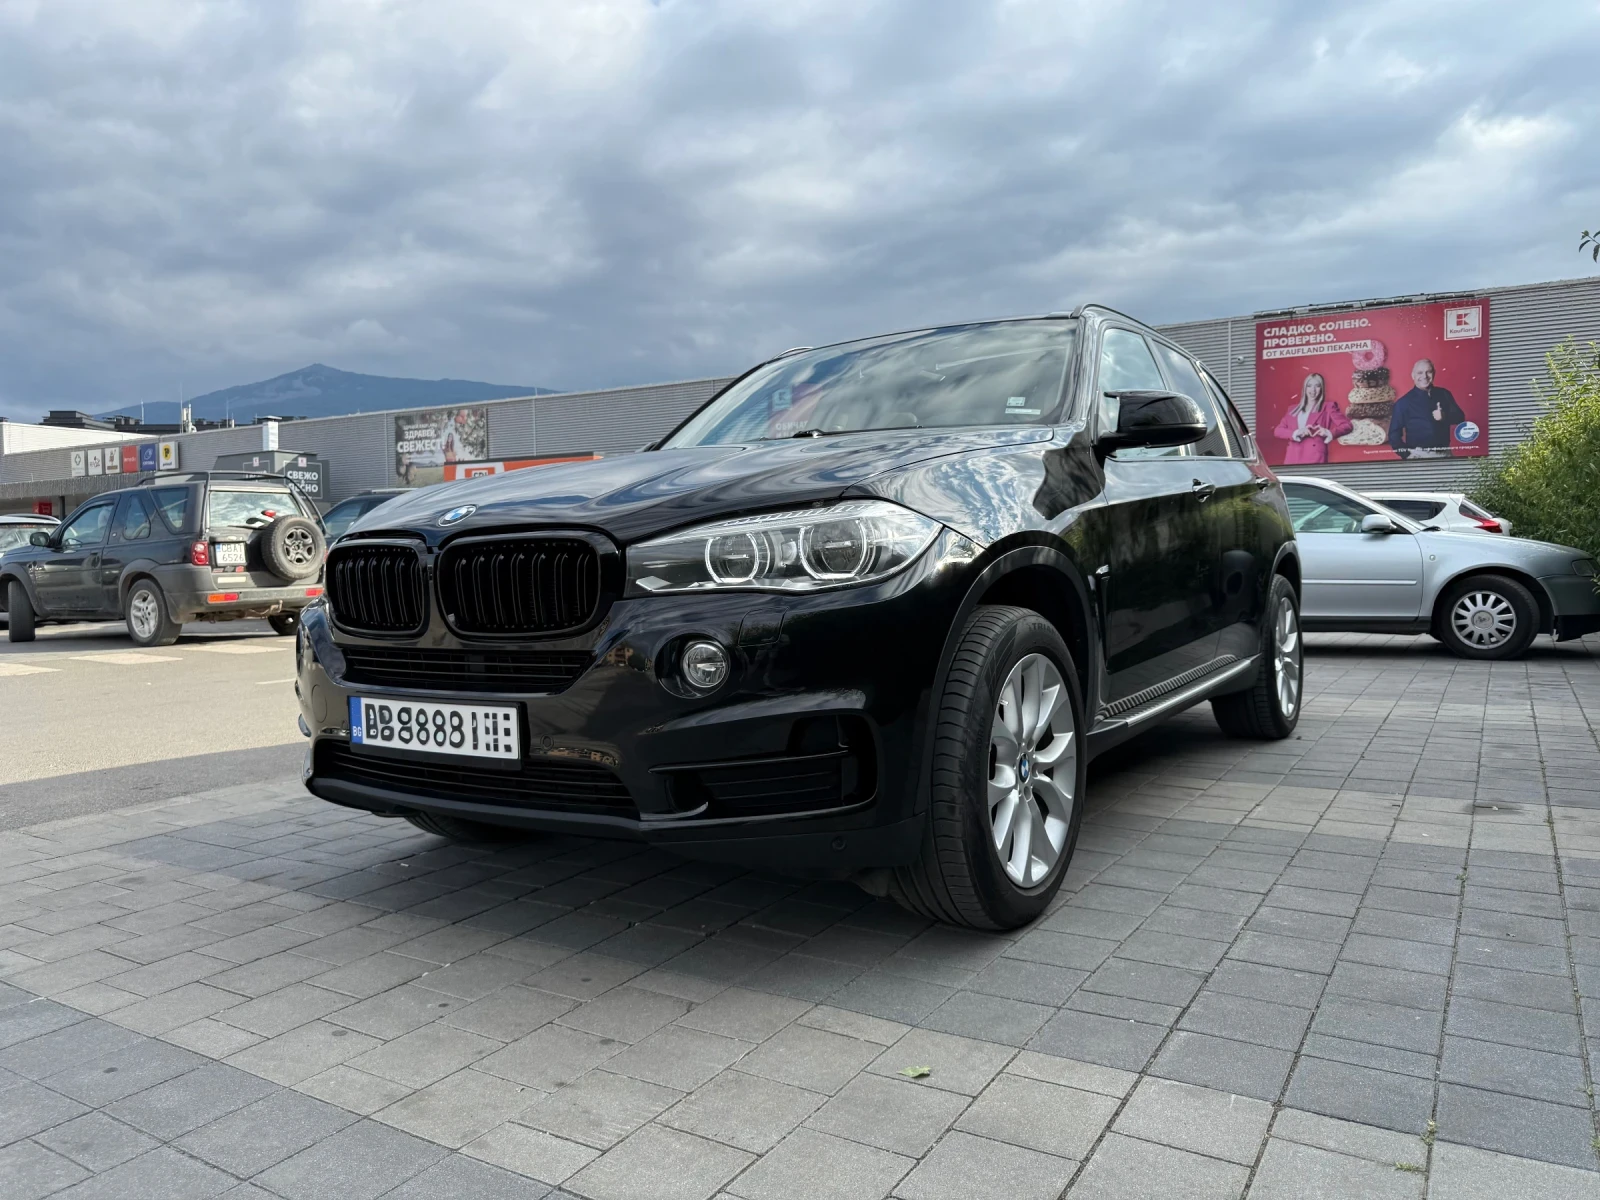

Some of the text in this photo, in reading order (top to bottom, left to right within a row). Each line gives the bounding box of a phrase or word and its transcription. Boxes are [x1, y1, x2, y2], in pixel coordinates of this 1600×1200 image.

[1263, 318, 1372, 337] СЛАДКО. СОЛЕНО.
[1263, 333, 1337, 348] ПРОВЕРЕНО.
[1265, 342, 1369, 358] ОТ KAUFLAND ПЕКАРНА
[287, 470, 318, 480] СВЕЖО
[352, 726, 362, 737] BG
